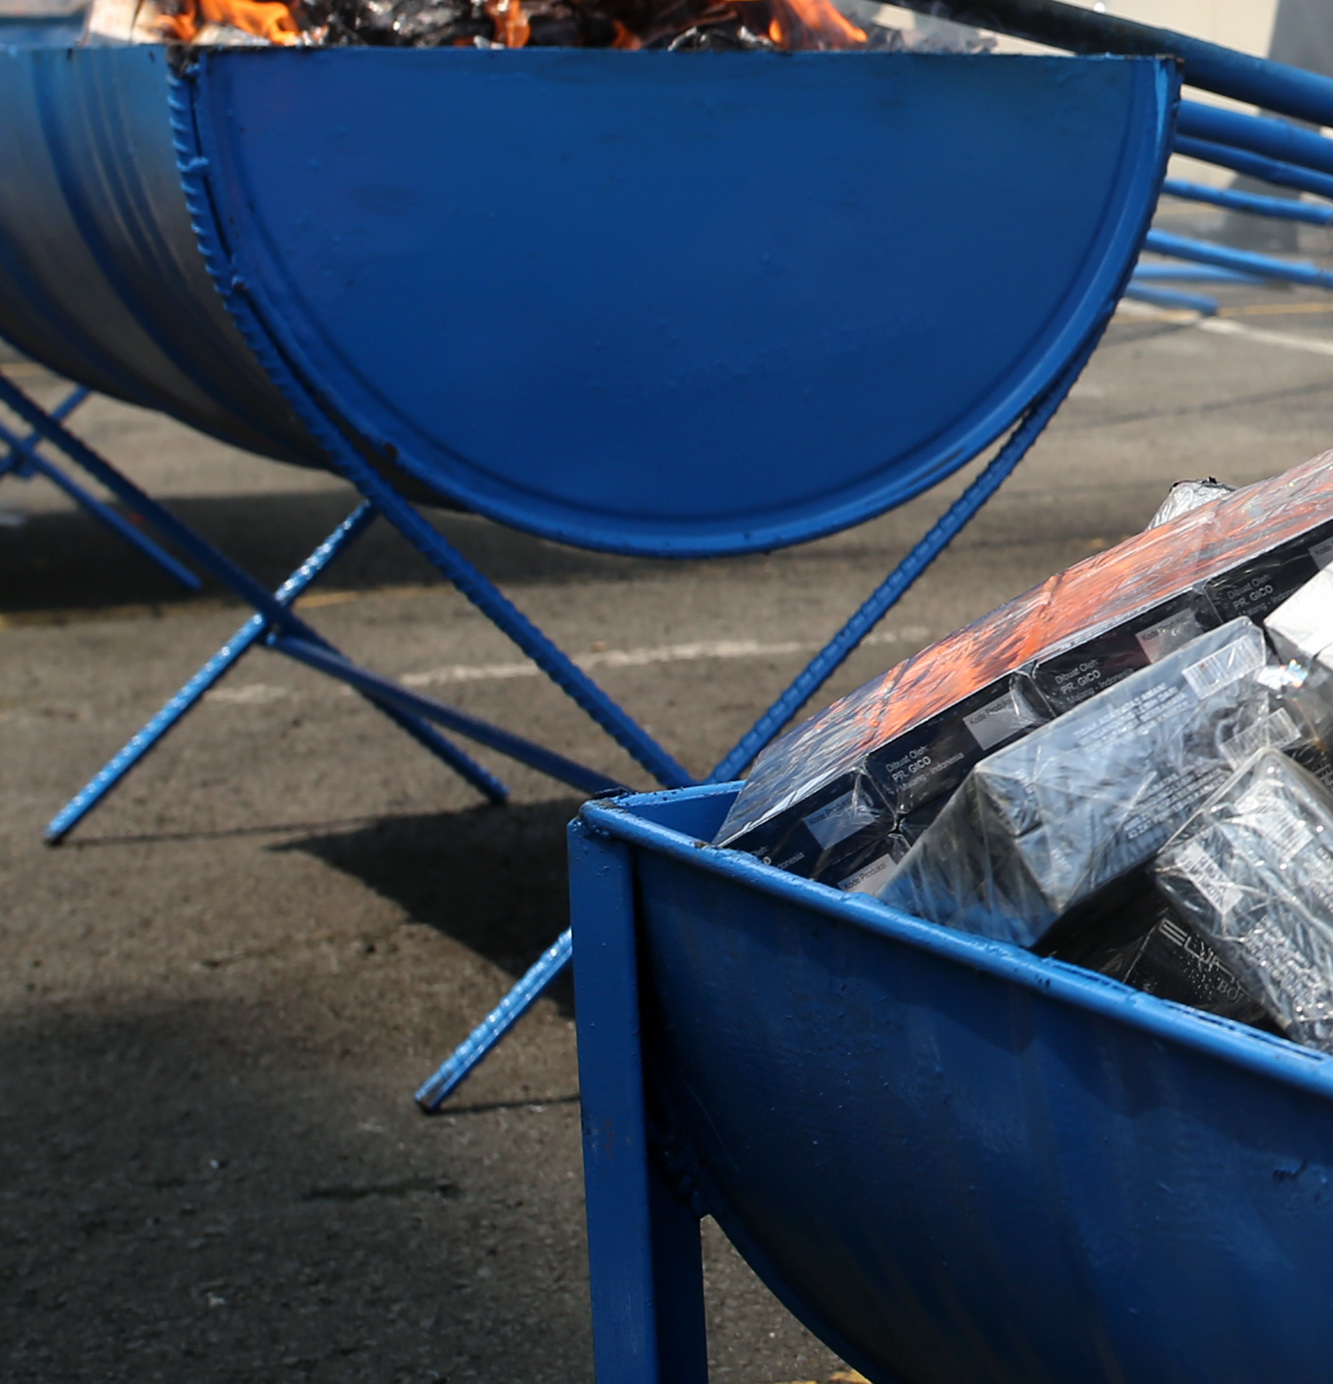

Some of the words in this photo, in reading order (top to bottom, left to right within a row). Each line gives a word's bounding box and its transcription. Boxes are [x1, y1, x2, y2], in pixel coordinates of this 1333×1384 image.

[1232, 596, 1249, 611] PR.
[1249, 584, 1274, 602] GICO
[1054, 663, 1080, 685] Dibuat
[1078, 657, 1098, 673] Oleh:
[1060, 679, 1077, 695] PR.
[1077, 669, 1102, 688] GICO
[885, 752, 911, 774] Dibuat
[909, 744, 930, 761] Oleh:
[891, 765, 908, 783] PR.
[907, 755, 932, 774] GICO
[929, 751, 965, 775] Indonesia
